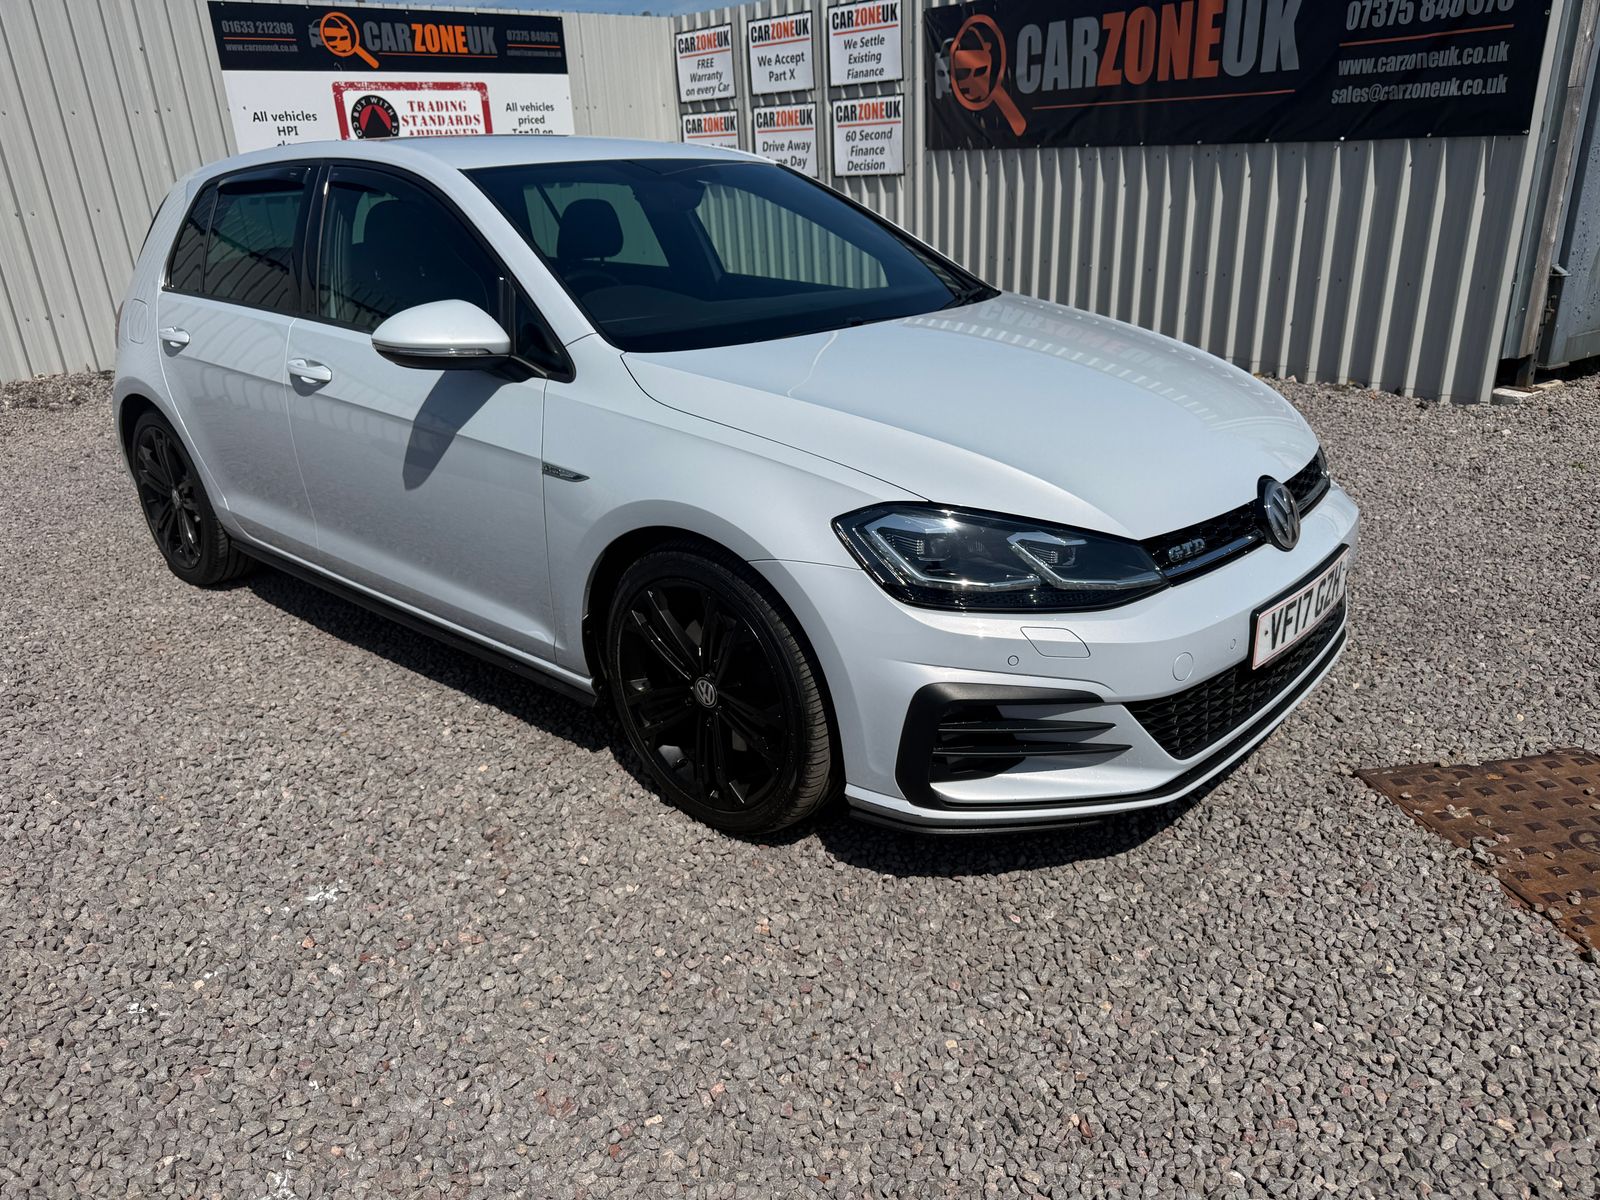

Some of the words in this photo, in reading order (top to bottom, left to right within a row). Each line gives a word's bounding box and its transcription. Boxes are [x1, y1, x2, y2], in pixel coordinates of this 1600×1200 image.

[832, 3, 898, 30] CARZONEUK
[1346, 0, 1414, 31] 07375
[222, 20, 255, 34] 01633
[256, 21, 294, 35] 212398
[751, 18, 809, 43] CARZONEUK
[363, 21, 498, 54] CARZONEUK
[678, 30, 730, 54] CARZONEUK
[844, 39, 858, 50] We
[860, 34, 885, 48] Settle
[1015, 0, 1300, 94] CARZONEUK
[697, 57, 714, 69] FREE
[757, 55, 772, 67] We
[775, 52, 805, 66] Accept
[848, 51, 882, 65] Existing
[1338, 41, 1510, 76] www.carzoneuk.co.uk
[690, 70, 723, 83] Warranty
[769, 70, 787, 82] Part
[789, 68, 796, 80] X
[847, 67, 885, 80] Fianance
[685, 88, 695, 96] on
[697, 85, 716, 96] every
[718, 82, 730, 92] Car
[1331, 74, 1508, 104] sales@carzoneuk.co.uk
[353, 99, 367, 118] BUY
[370, 96, 394, 116] WITH
[407, 100, 467, 112] TRADING
[505, 102, 518, 112] All
[520, 102, 555, 112] vehicles
[836, 100, 901, 123] CARZONEUK
[252, 110, 268, 122] All
[271, 110, 317, 122] vehicles
[401, 114, 481, 127] STANDARDS
[518, 115, 545, 127] priced
[756, 109, 813, 128] CARZONEUK
[277, 126, 299, 136] HPI
[685, 116, 736, 134] CARZONEUK
[845, 130, 857, 142] 60
[859, 127, 893, 141] Second
[762, 141, 785, 153] Drive
[787, 140, 812, 153] Away
[850, 145, 885, 157] Finance
[790, 156, 808, 170] Day
[847, 159, 885, 172] Decision
[1168, 538, 1206, 562] GTD
[1271, 587, 1314, 651] VF17
[1315, 560, 1343, 618] GZH
